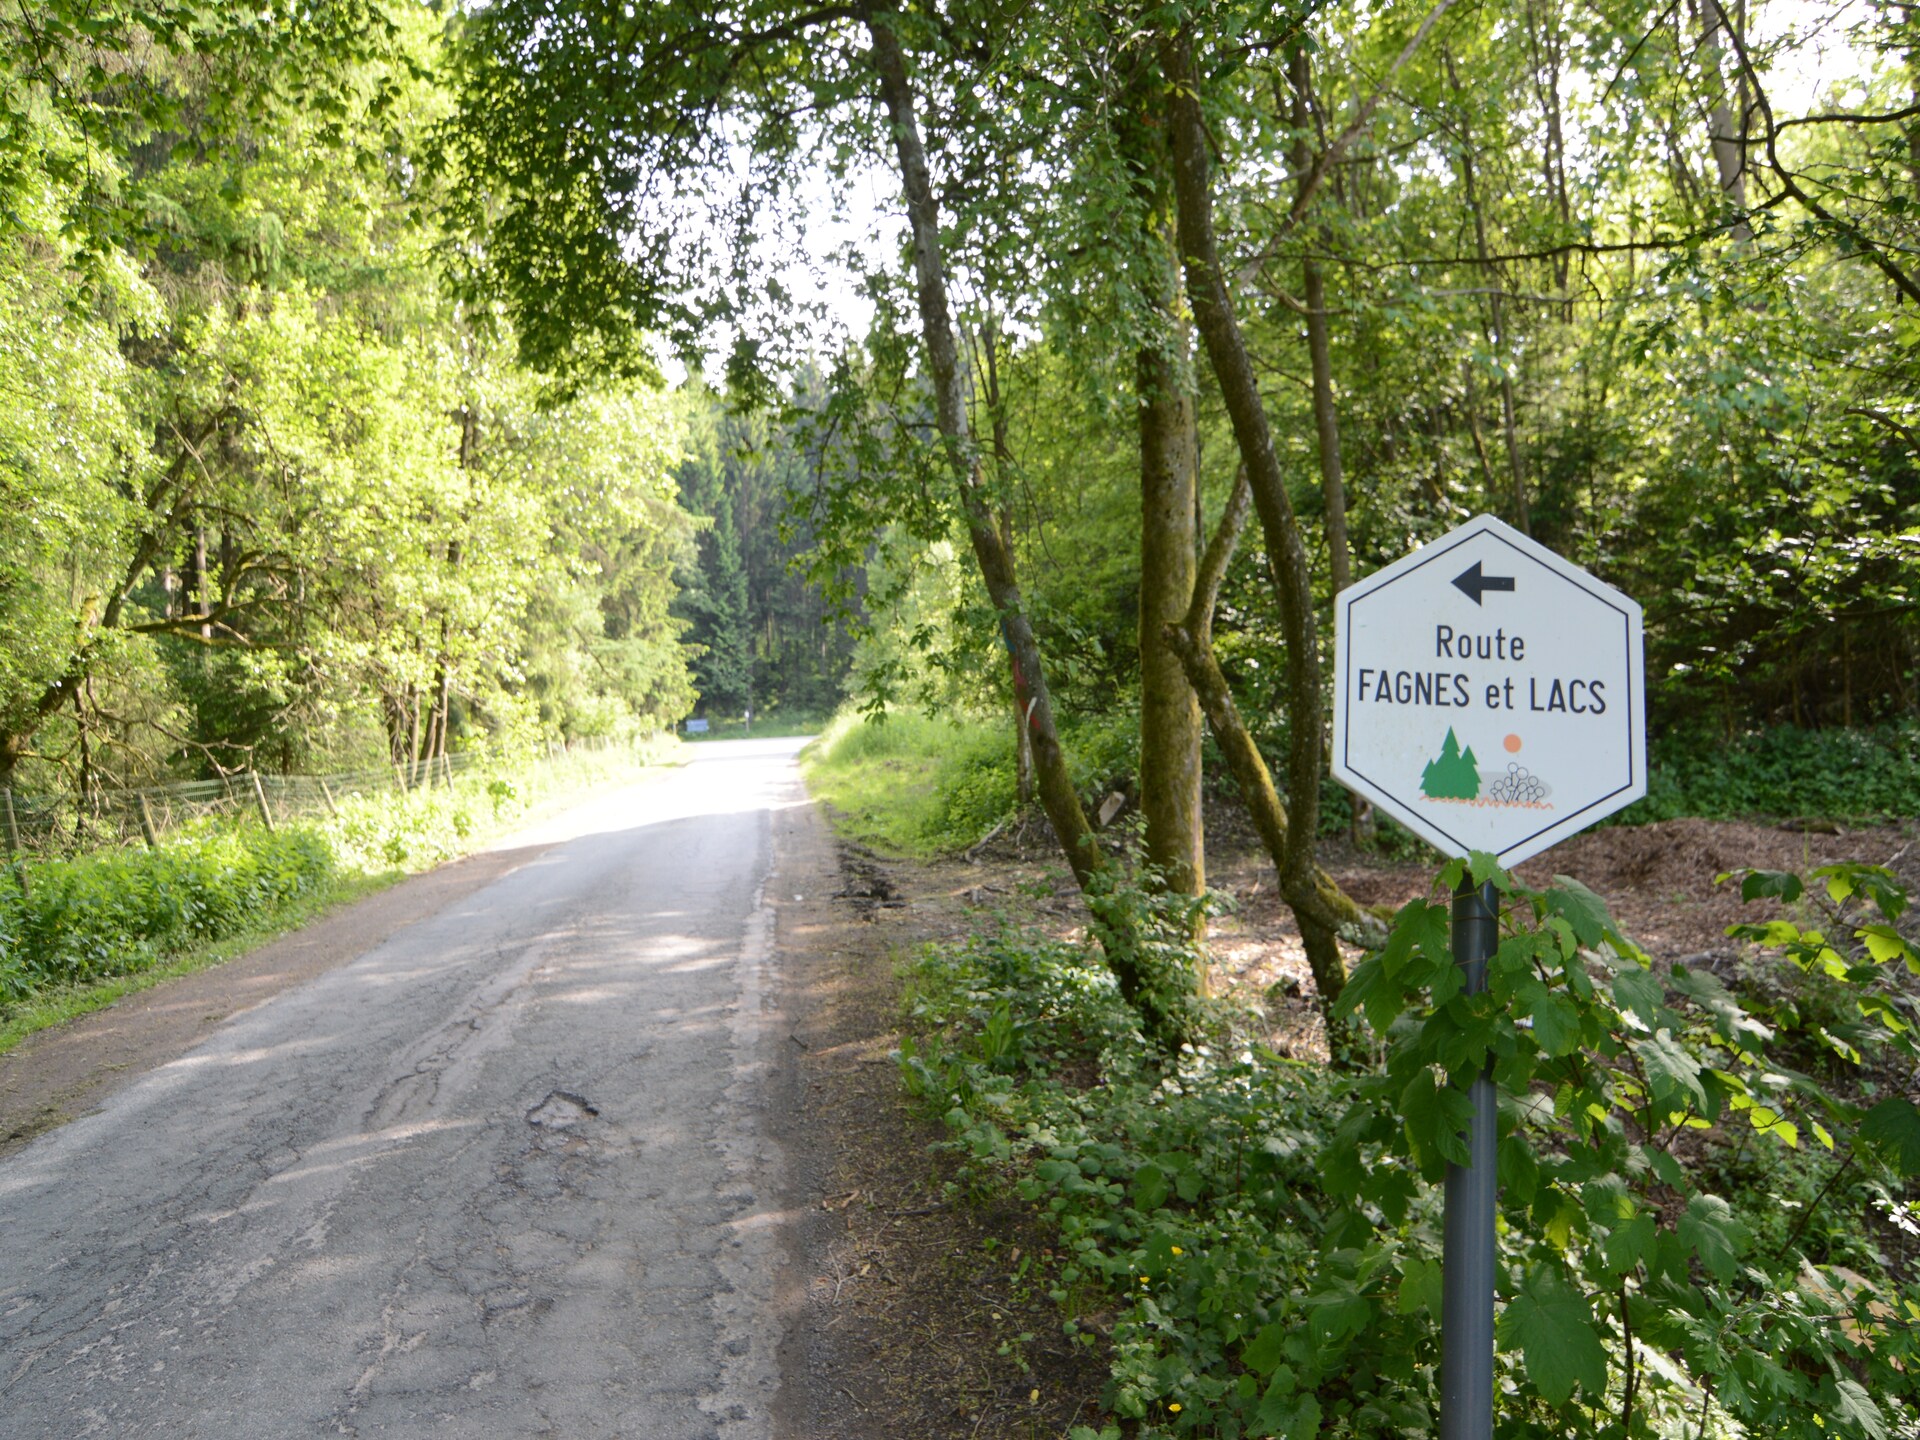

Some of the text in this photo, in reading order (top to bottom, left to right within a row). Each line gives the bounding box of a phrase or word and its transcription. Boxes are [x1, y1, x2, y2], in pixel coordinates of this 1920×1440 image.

[1436, 624, 1525, 661] Route
[1358, 668, 1607, 715] FAGNES et LACS
